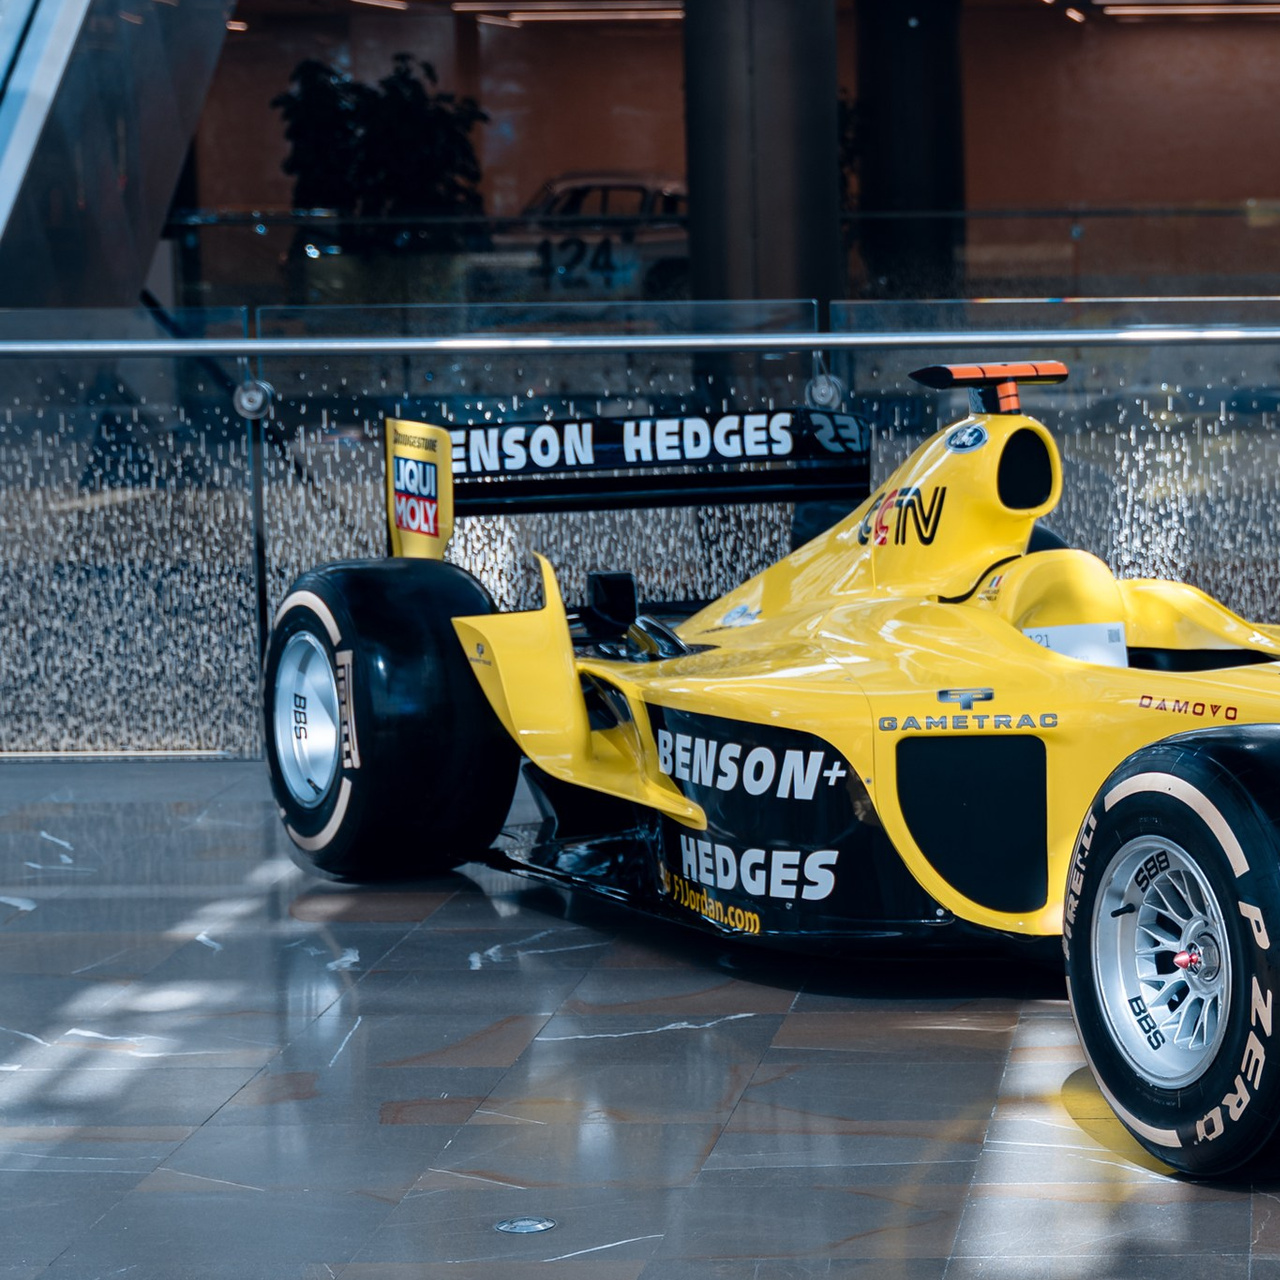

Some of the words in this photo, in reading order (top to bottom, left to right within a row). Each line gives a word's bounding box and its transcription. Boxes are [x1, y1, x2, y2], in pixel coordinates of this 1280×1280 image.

[452, 423, 595, 473] ENSON
[623, 412, 793, 463] HEDGES
[394, 458, 436, 497] LIQUI
[395, 495, 438, 534] MOLY
[293, 692, 308, 740] BBS
[878, 713, 1059, 732] GAMETRAC
[1138, 694, 1238, 721] DAMOVO
[679, 833, 840, 901] HEDGES
[1133, 850, 1171, 894] BBS
[1237, 901, 1270, 951] P
[1127, 995, 1167, 1051] BBS
[1195, 976, 1274, 1142] ZERO
